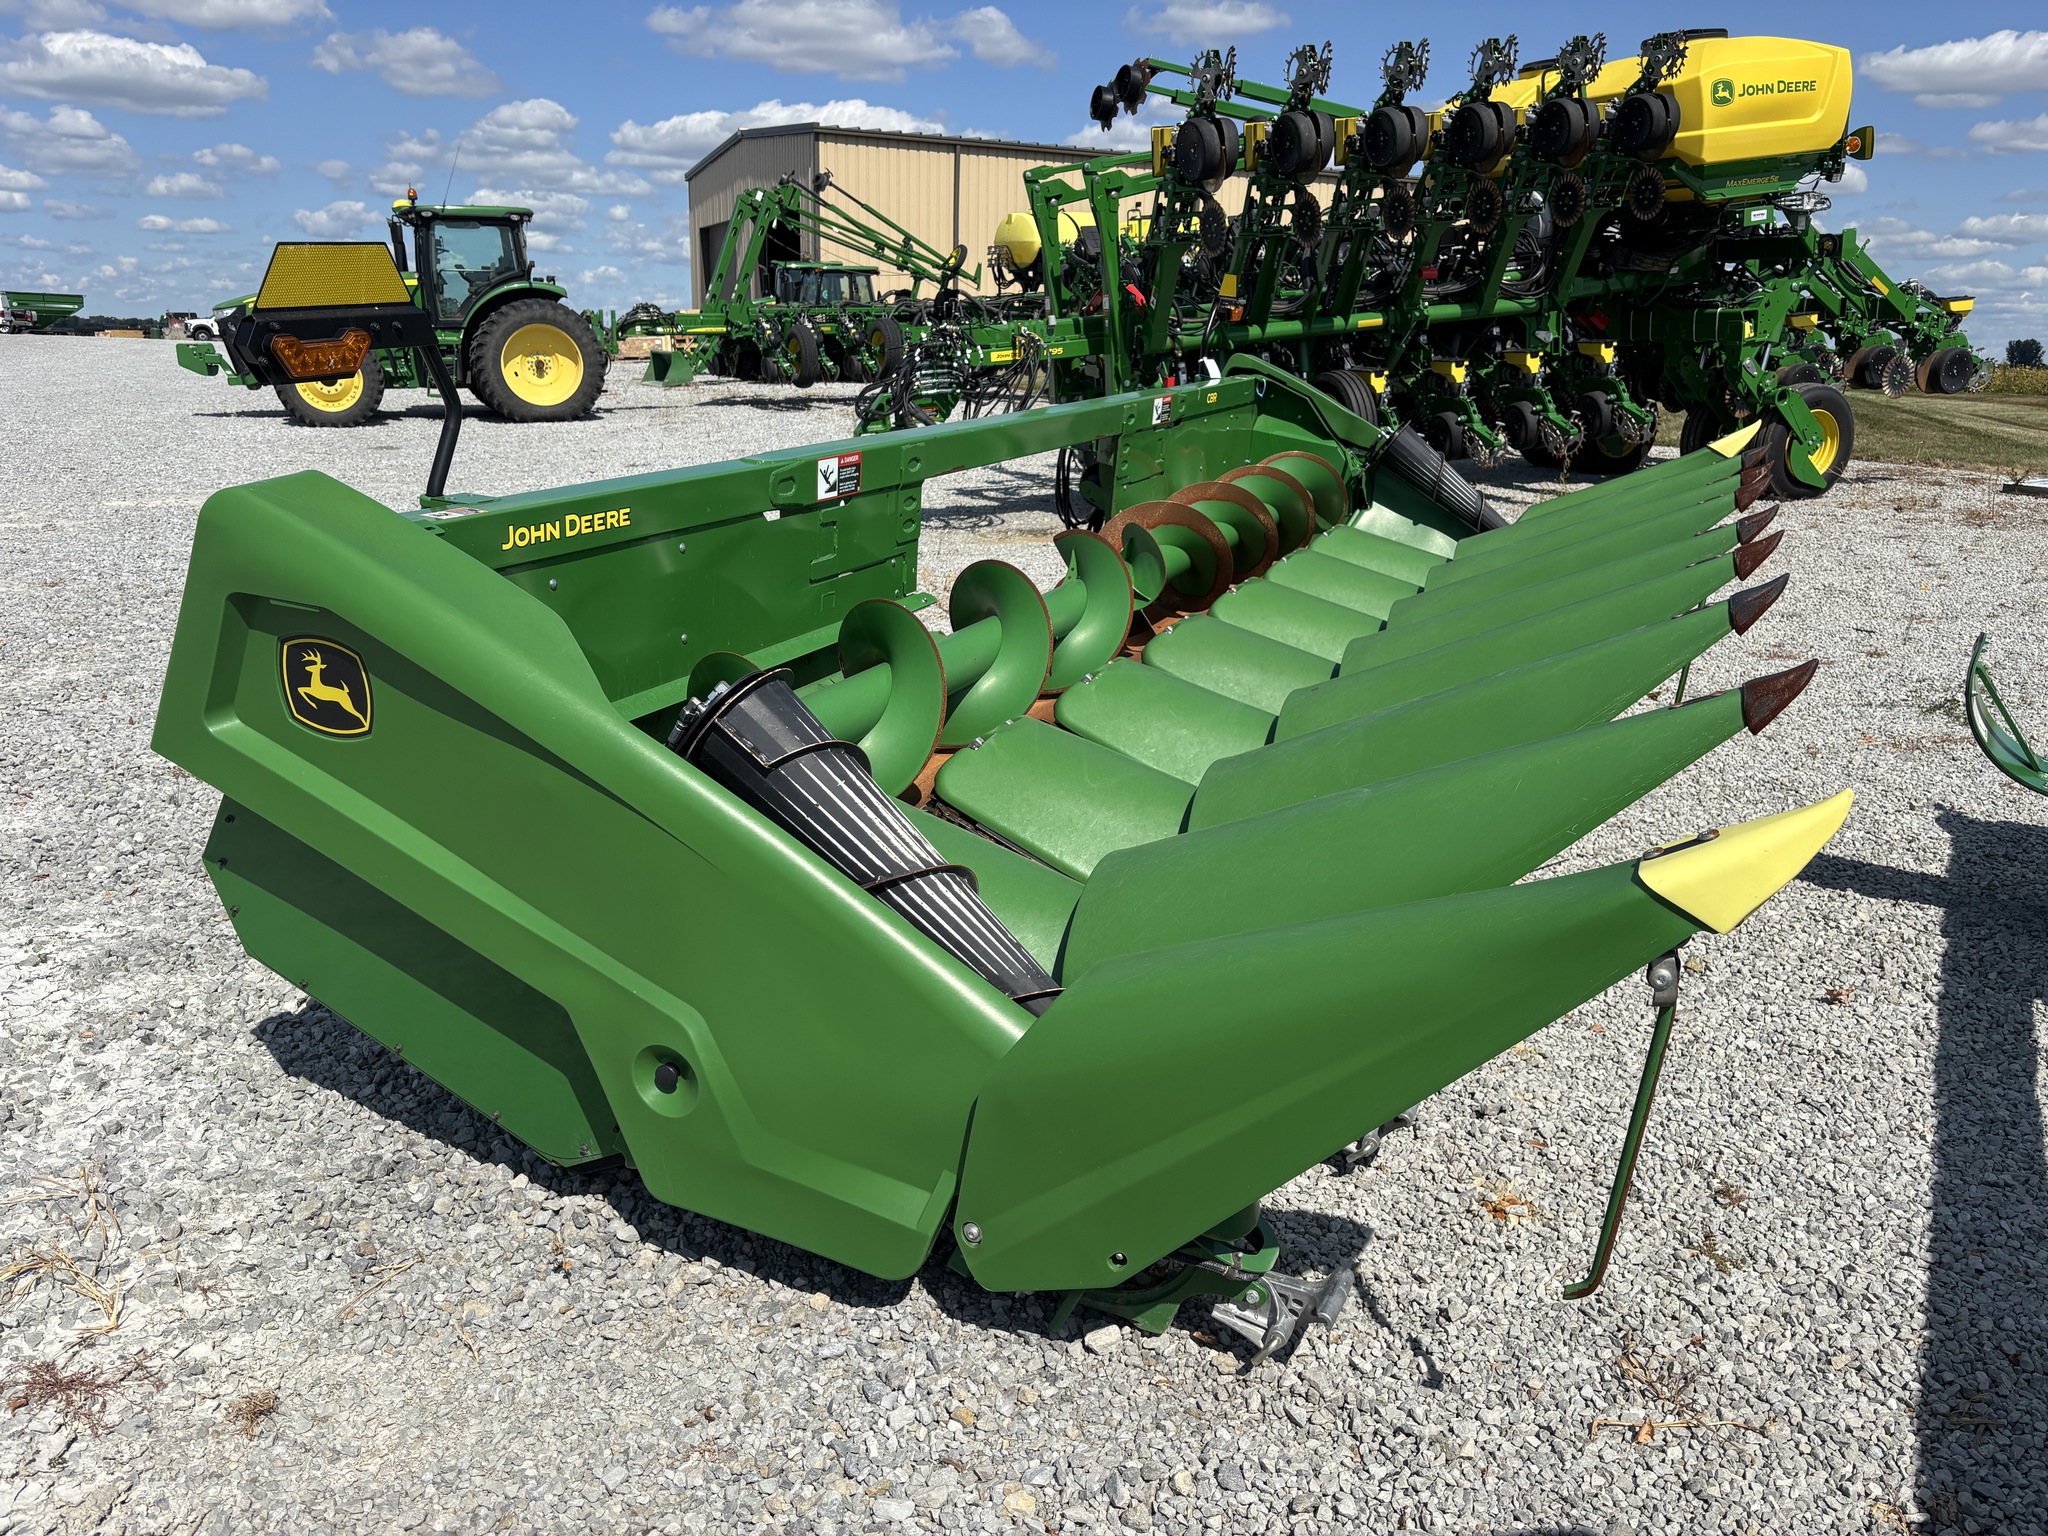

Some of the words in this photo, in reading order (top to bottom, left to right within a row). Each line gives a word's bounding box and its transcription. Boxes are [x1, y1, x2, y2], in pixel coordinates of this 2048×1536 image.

[1738, 82, 1775, 98] JOHN
[1777, 80, 1817, 93] DEERE
[1043, 347, 1064, 356] 195
[844, 454, 859, 464] DANGER
[501, 519, 561, 551] JOHN
[564, 507, 631, 539] DEERE
